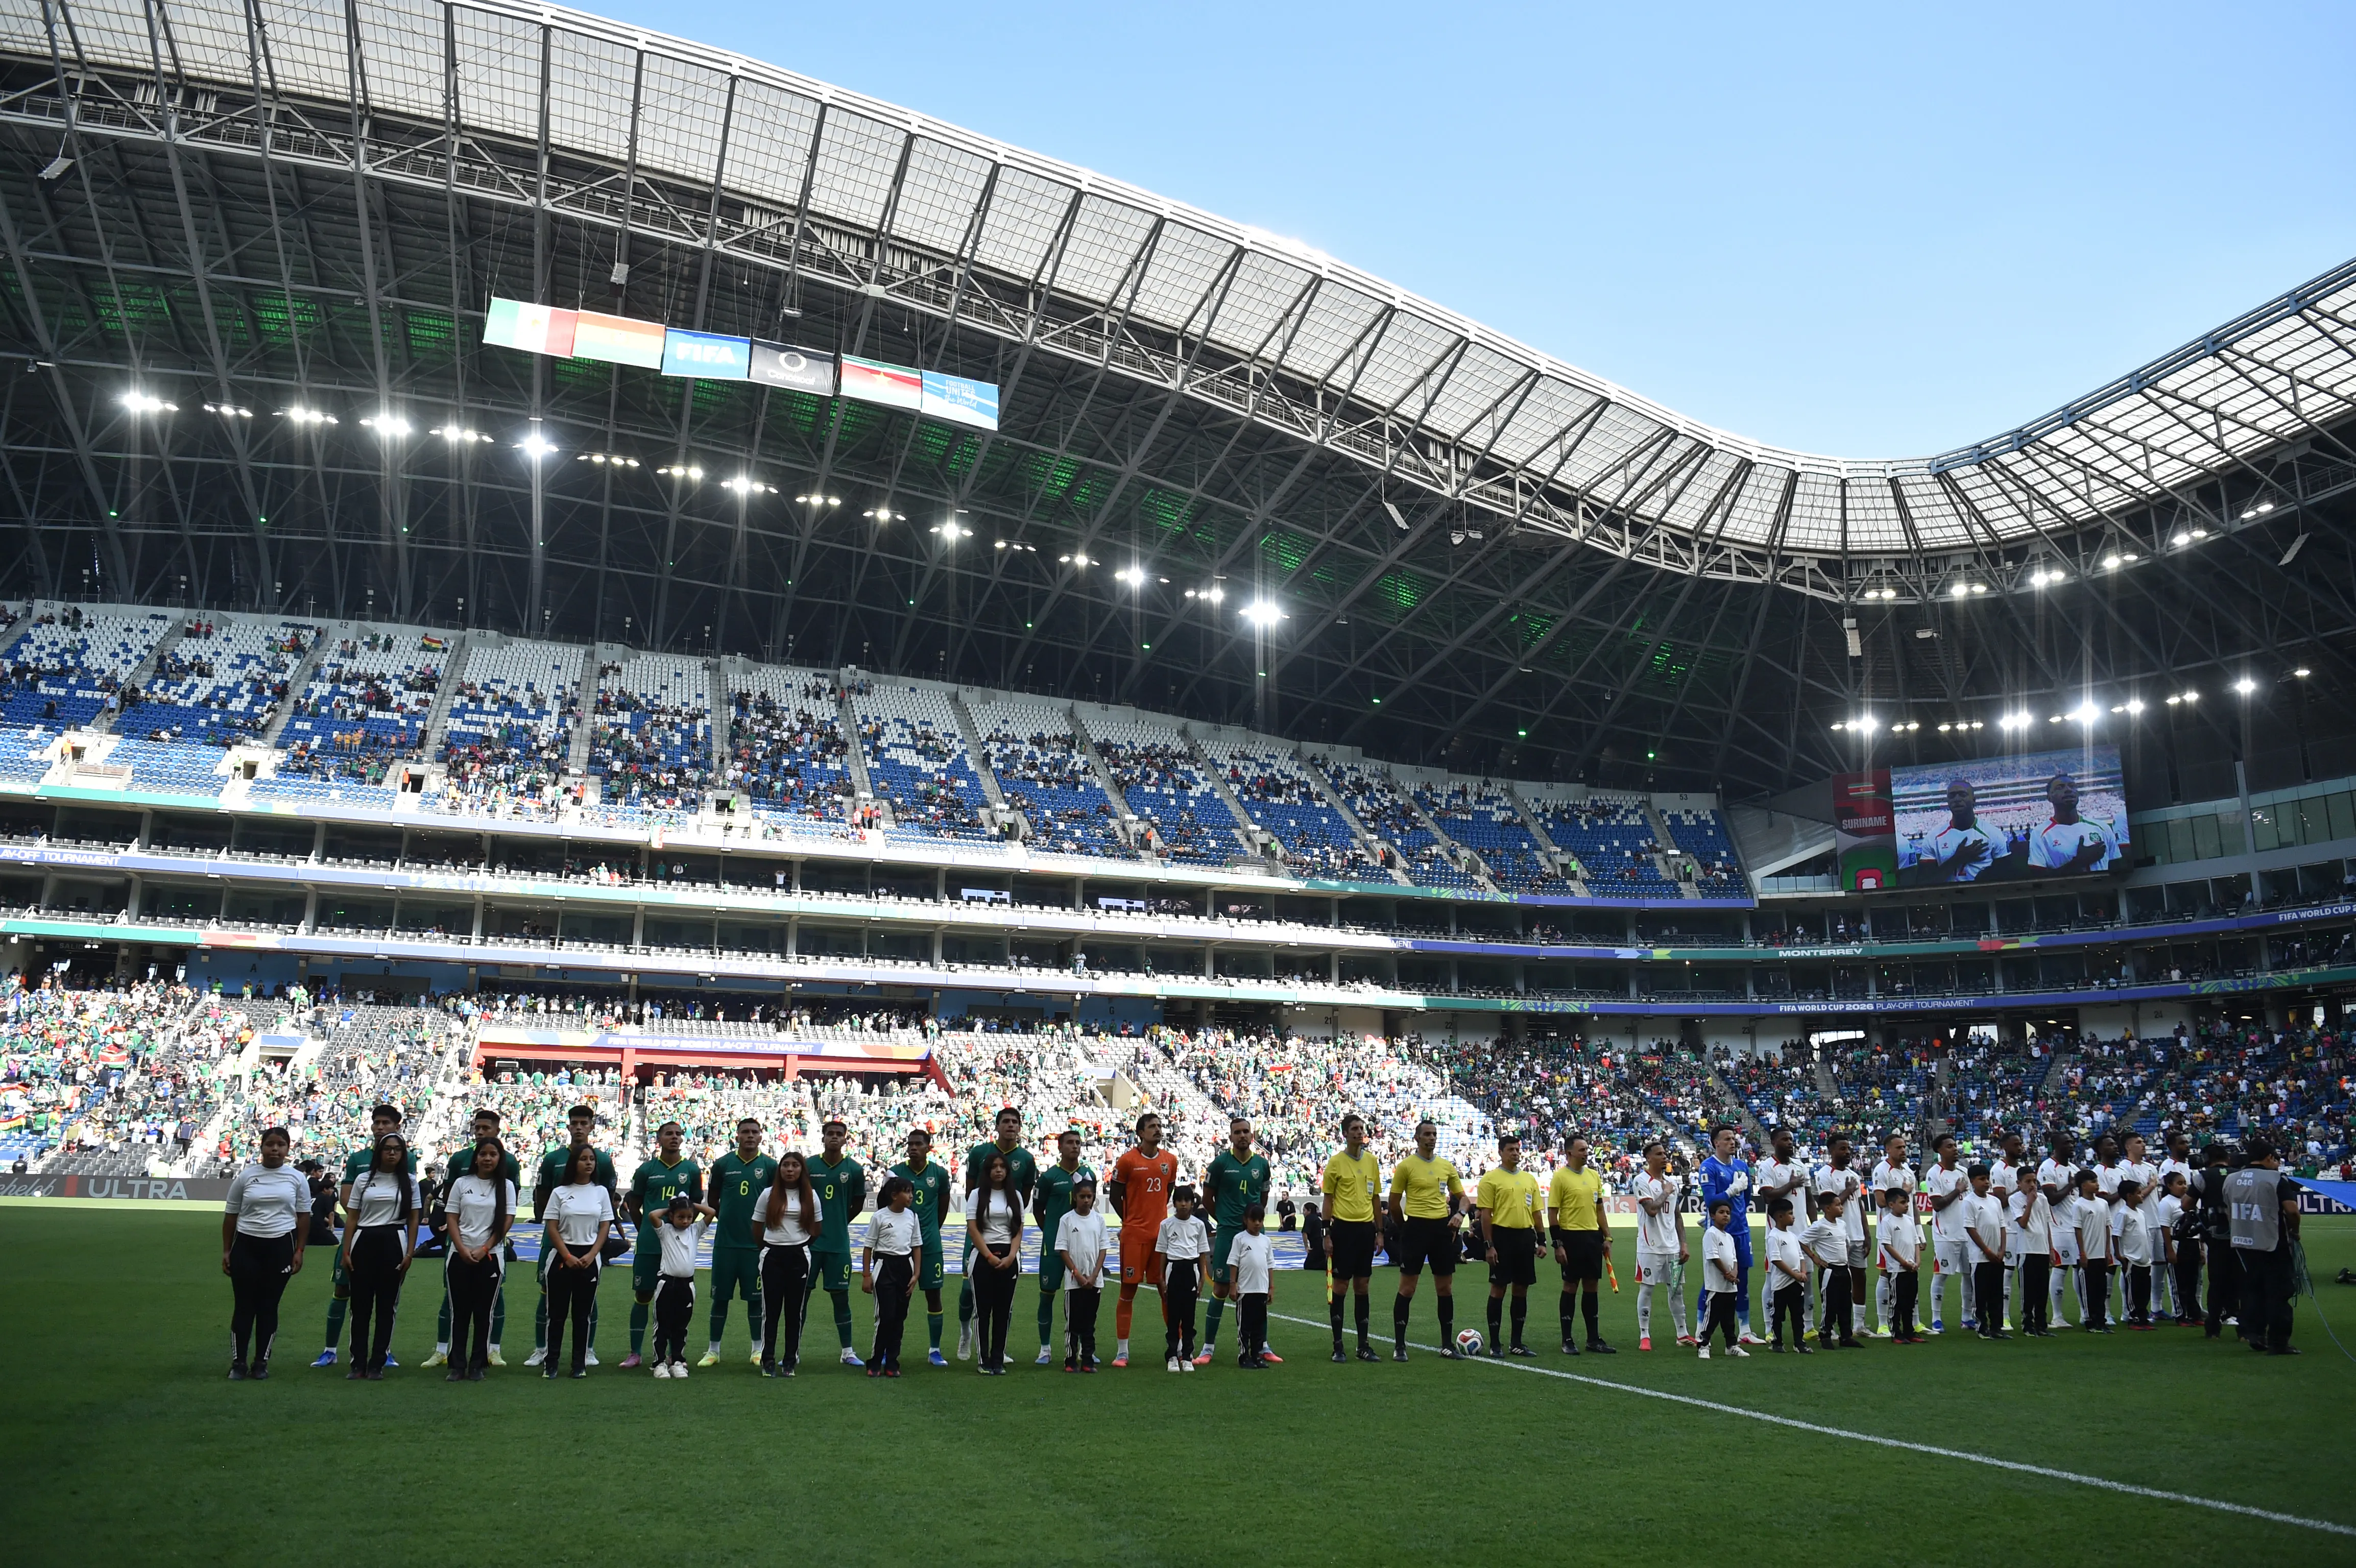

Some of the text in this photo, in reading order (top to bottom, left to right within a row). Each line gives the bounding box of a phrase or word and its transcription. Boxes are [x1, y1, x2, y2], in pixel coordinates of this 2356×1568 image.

[677, 343, 736, 364] FIFA
[946, 379, 975, 391] FOOTBALL
[946, 385, 976, 397] UNITES
[944, 394, 978, 409] the World
[1842, 816, 1887, 829] SURINAME
[43, 852, 121, 865] TOURNAMENT
[2279, 913, 2298, 921] FIFA
[2298, 908, 2331, 919] WORLD
[2333, 906, 2351, 915] CUP
[59, 943, 87, 951] SALID
[1778, 948, 1863, 957] MONTERREY
[121, 956, 129, 964] 19
[250, 963, 256, 973] A
[384, 966, 390, 975] B
[562, 971, 568, 980] C
[696, 978, 702, 987] D
[847, 986, 852, 995] E
[1003, 998, 1008, 1006] F
[1876, 1001, 1914, 1010] PLAY-OFF
[1916, 999, 1975, 1009] TOURNAMENT
[1109, 1006, 1115, 1015] G
[2154, 1010, 2162, 1019] 24
[1325, 1017, 1332, 1025] 21
[629, 1038, 661, 1047] WORLD
[712, 1041, 753, 1050] PLAY-OFF
[754, 1042, 814, 1052] TOURNAMENT
[89, 1179, 188, 1200] ULTRA
[740, 1180, 749, 1196] 6
[1146, 1177, 1162, 1192] 23
[1239, 1180, 1247, 1194] 4
[661, 1186, 676, 1200] 14
[825, 1185, 833, 1199] 9
[916, 1190, 923, 1205] 3
[1791, 1189, 1797, 1197] 4
[1661, 1201, 1670, 1214] 10
[2231, 1203, 2263, 1222] IFA
[843, 1264, 849, 1279] 9
[934, 1263, 941, 1277] 3
